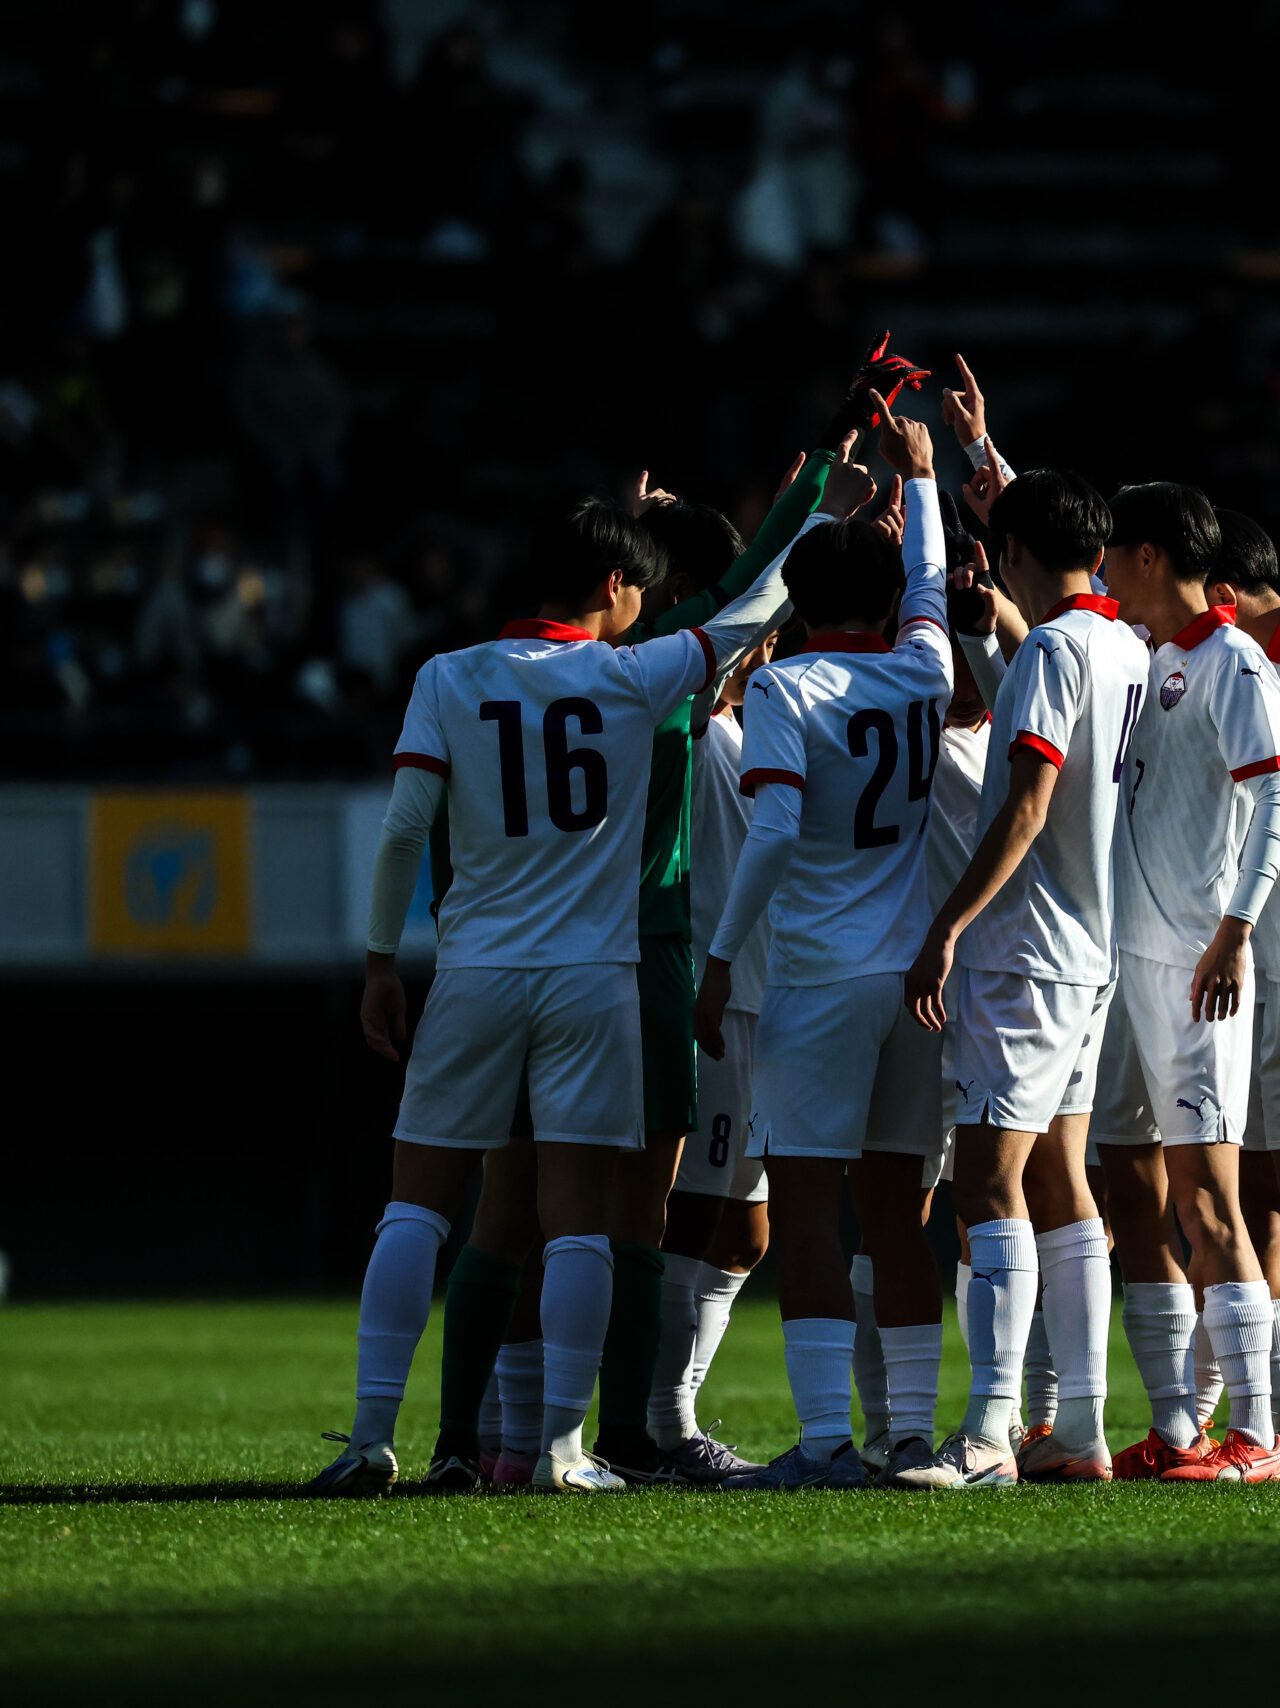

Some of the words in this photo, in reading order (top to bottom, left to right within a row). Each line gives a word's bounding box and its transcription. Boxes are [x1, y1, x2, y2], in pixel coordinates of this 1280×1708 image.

[479, 697, 608, 837] 16
[847, 698, 941, 849] 24
[708, 1113, 732, 1168] 8
